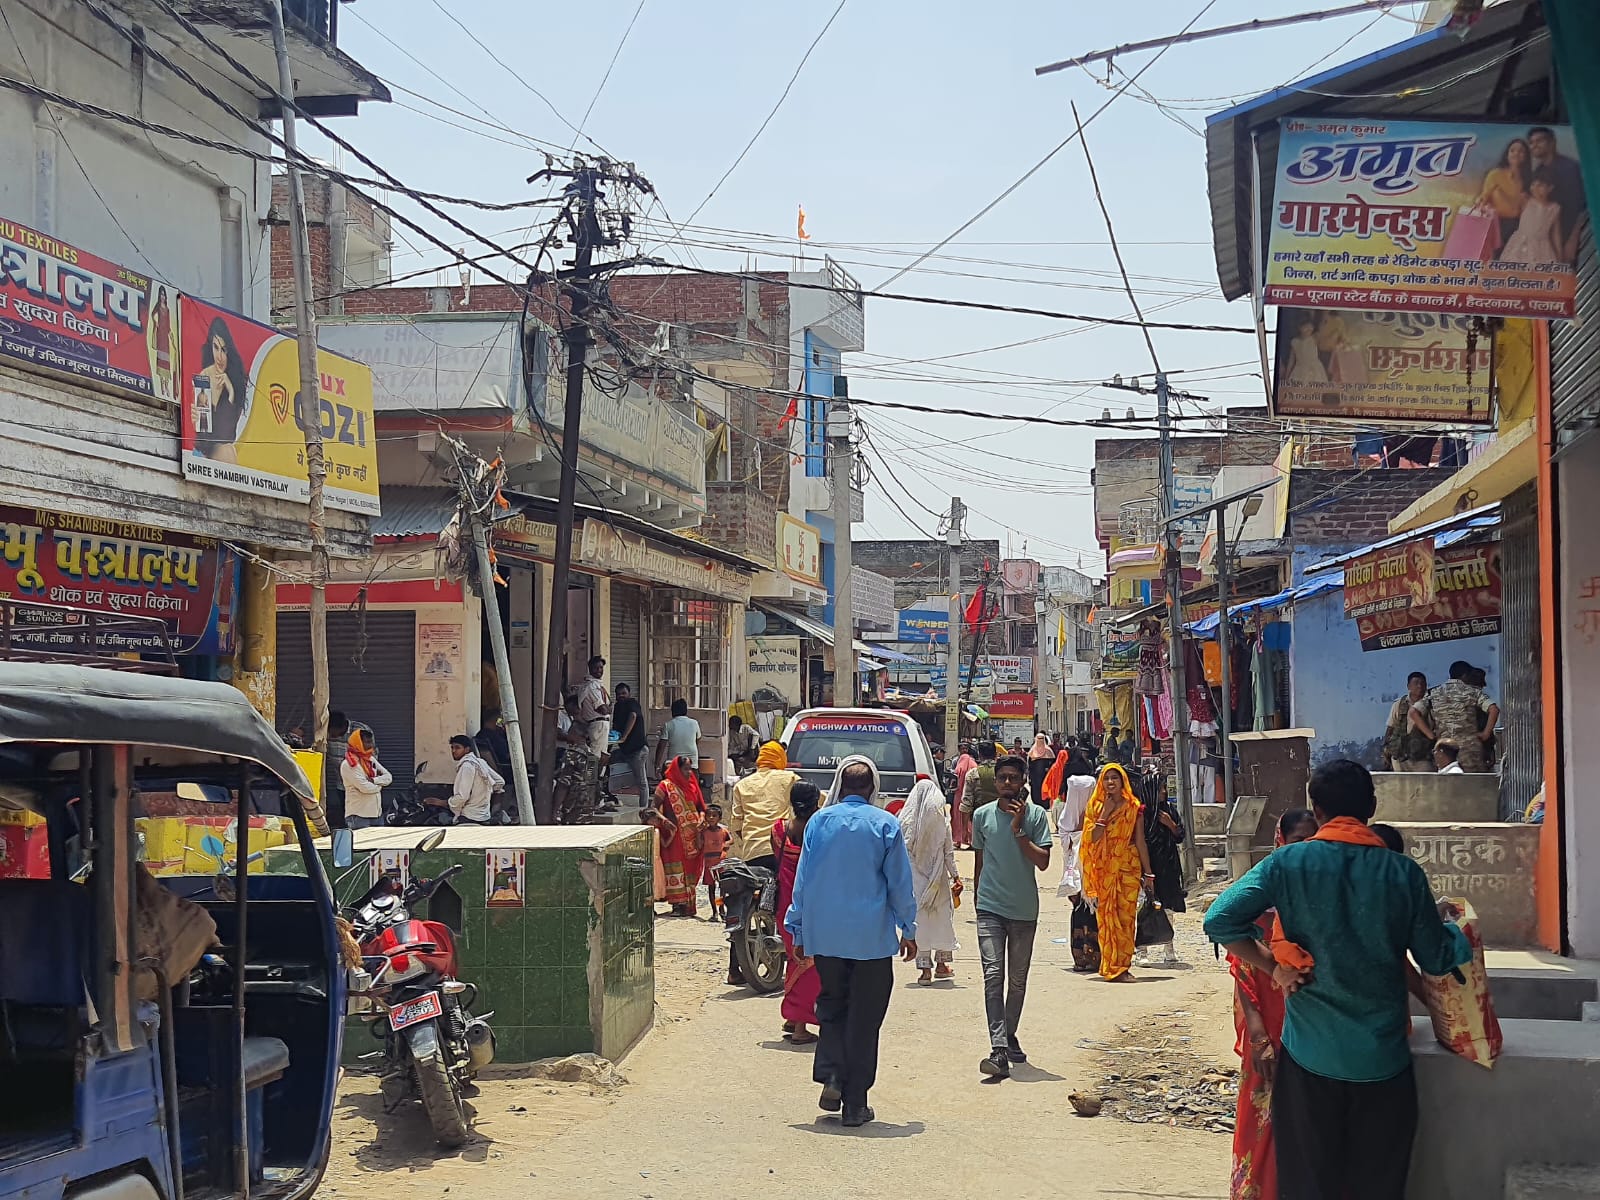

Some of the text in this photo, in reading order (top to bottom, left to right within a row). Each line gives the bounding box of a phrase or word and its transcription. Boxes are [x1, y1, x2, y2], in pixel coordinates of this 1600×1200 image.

[1316, 123, 1347, 135] अमृत
[1350, 124, 1386, 137] कुमार
[1286, 136, 1475, 195] अमृत
[1277, 193, 1448, 250] गारमेन्ट्स
[19, 229, 78, 264] TEXTILES
[1273, 250, 1301, 263] हमारे
[1303, 250, 1325, 264] यहाँ
[1327, 251, 1350, 265] सभी
[1352, 255, 1375, 266] तरह
[1378, 253, 1389, 266] के
[1321, 267, 1338, 281] शर्ट
[1340, 269, 1365, 282] आदि
[1368, 272, 1400, 286] कपड़ा
[1429, 274, 1441, 286] के
[1444, 275, 1465, 287] भाव
[1468, 274, 1478, 286] में
[1507, 275, 1543, 289] मिलता
[1271, 287, 1293, 300] पता
[1344, 290, 1367, 302] स्टेट
[1370, 289, 1392, 305] बैंक
[1395, 291, 1408, 305] के
[1411, 294, 1444, 306] बगल
[13, 298, 58, 323] खुदरा
[5, 340, 35, 358] रजाई
[38, 349, 66, 366] उचित
[67, 358, 90, 374] मूल्य
[92, 365, 105, 378] पर
[107, 367, 137, 386] मिलता
[320, 372, 346, 397] UX
[187, 463, 289, 494] SHREE SHAMBHU VASTRALAY
[336, 463, 350, 480] कुछ
[353, 464, 367, 482] नहीं
[35, 510, 163, 542] M/s SHAMBHU TEXTILES
[54, 529, 203, 588] वस्त्रालय
[50, 585, 82, 602] थोक
[85, 589, 104, 604] एवं
[107, 592, 140, 610] खुदरा
[18, 609, 65, 617] GWALIOR
[26, 615, 63, 623] SUITING
[1434, 628, 1440, 640] व
[1461, 621, 1470, 635] के
[1471, 619, 1498, 635] विक्रेता
[812, 723, 889, 733] HIGHWAY PATROL
[1410, 835, 1507, 872] ग्राहक
